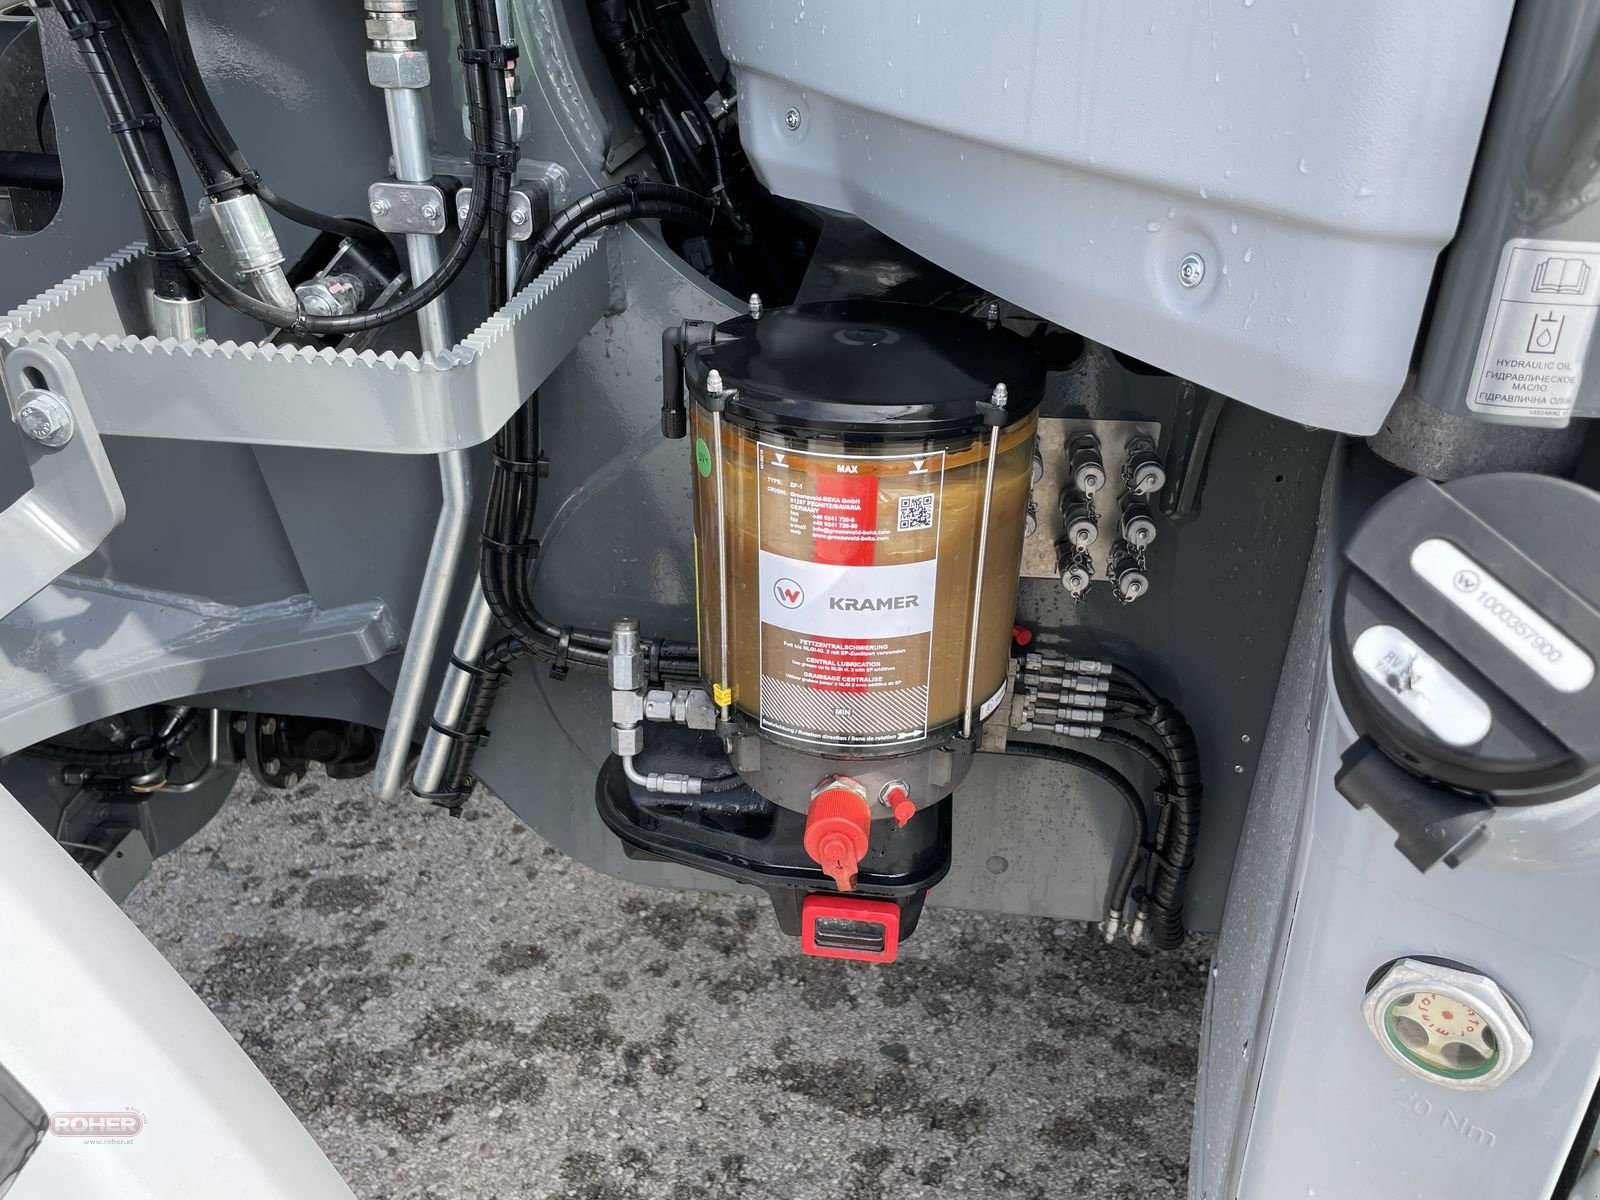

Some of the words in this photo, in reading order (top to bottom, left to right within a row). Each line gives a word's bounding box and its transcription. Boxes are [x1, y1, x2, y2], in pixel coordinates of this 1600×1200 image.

[1496, 358, 1554, 370] HYDRAULIC
[1556, 362, 1573, 371] OIL
[1485, 370, 1577, 384] ГИДРАВЛИЧЕСКОЕ
[1511, 383, 1548, 392] МАСЛО
[1480, 391, 1547, 405] ГІДРАВЛИЧНА
[836, 464, 858, 474] MAX
[767, 476, 783, 486] TYPE:
[767, 486, 788, 496] ORIGIN:
[789, 491, 840, 503] Groeneveld-BEKA
[789, 504, 820, 513] GERMANY
[806, 500, 862, 511] PEGNITZ/BAVARIA
[829, 594, 919, 611] KRAMER
[1477, 591, 1563, 663] 1000357900
[799, 638, 889, 651] FETTZENTRALSCHMIERUNG
[805, 657, 836, 667] CENTRAL
[837, 660, 881, 668] LUBRICATION
[803, 671, 841, 682] GRAISSAGE
[834, 708, 851, 716] MIN
[762, 718, 795, 734] Drehrichtung
[797, 730, 822, 738] Rotation
[1395, 1090, 1433, 1117] 20
[1441, 1109, 1497, 1148] Nm
